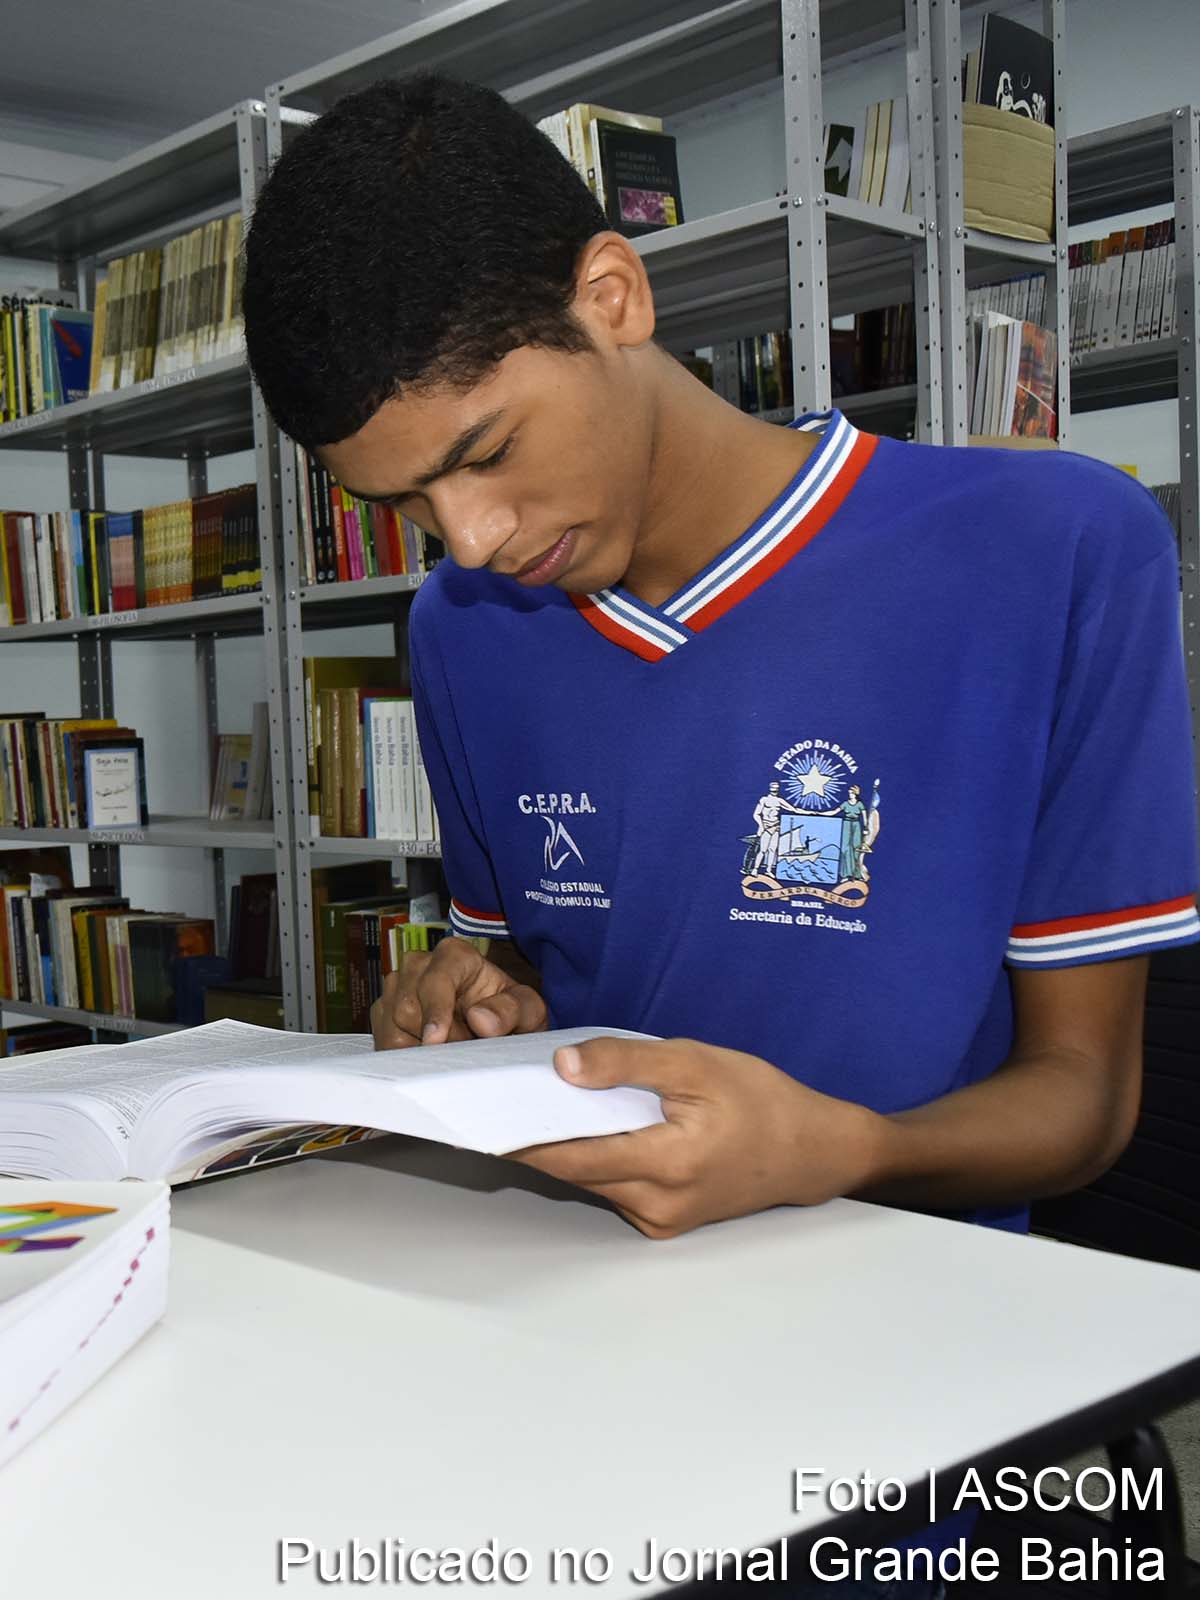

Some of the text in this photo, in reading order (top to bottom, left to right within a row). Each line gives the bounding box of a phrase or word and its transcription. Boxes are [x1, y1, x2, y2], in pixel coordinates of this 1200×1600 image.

[388, 743, 396, 766] Bahia
[774, 739, 858, 774] ESTADO DA BAHIA
[518, 792, 597, 814] C.E.P.R.A.
[560, 882, 605, 894] ESTADUAL
[791, 900, 824, 909] BRASIL
[729, 908, 867, 933] Secretaria da Educação
